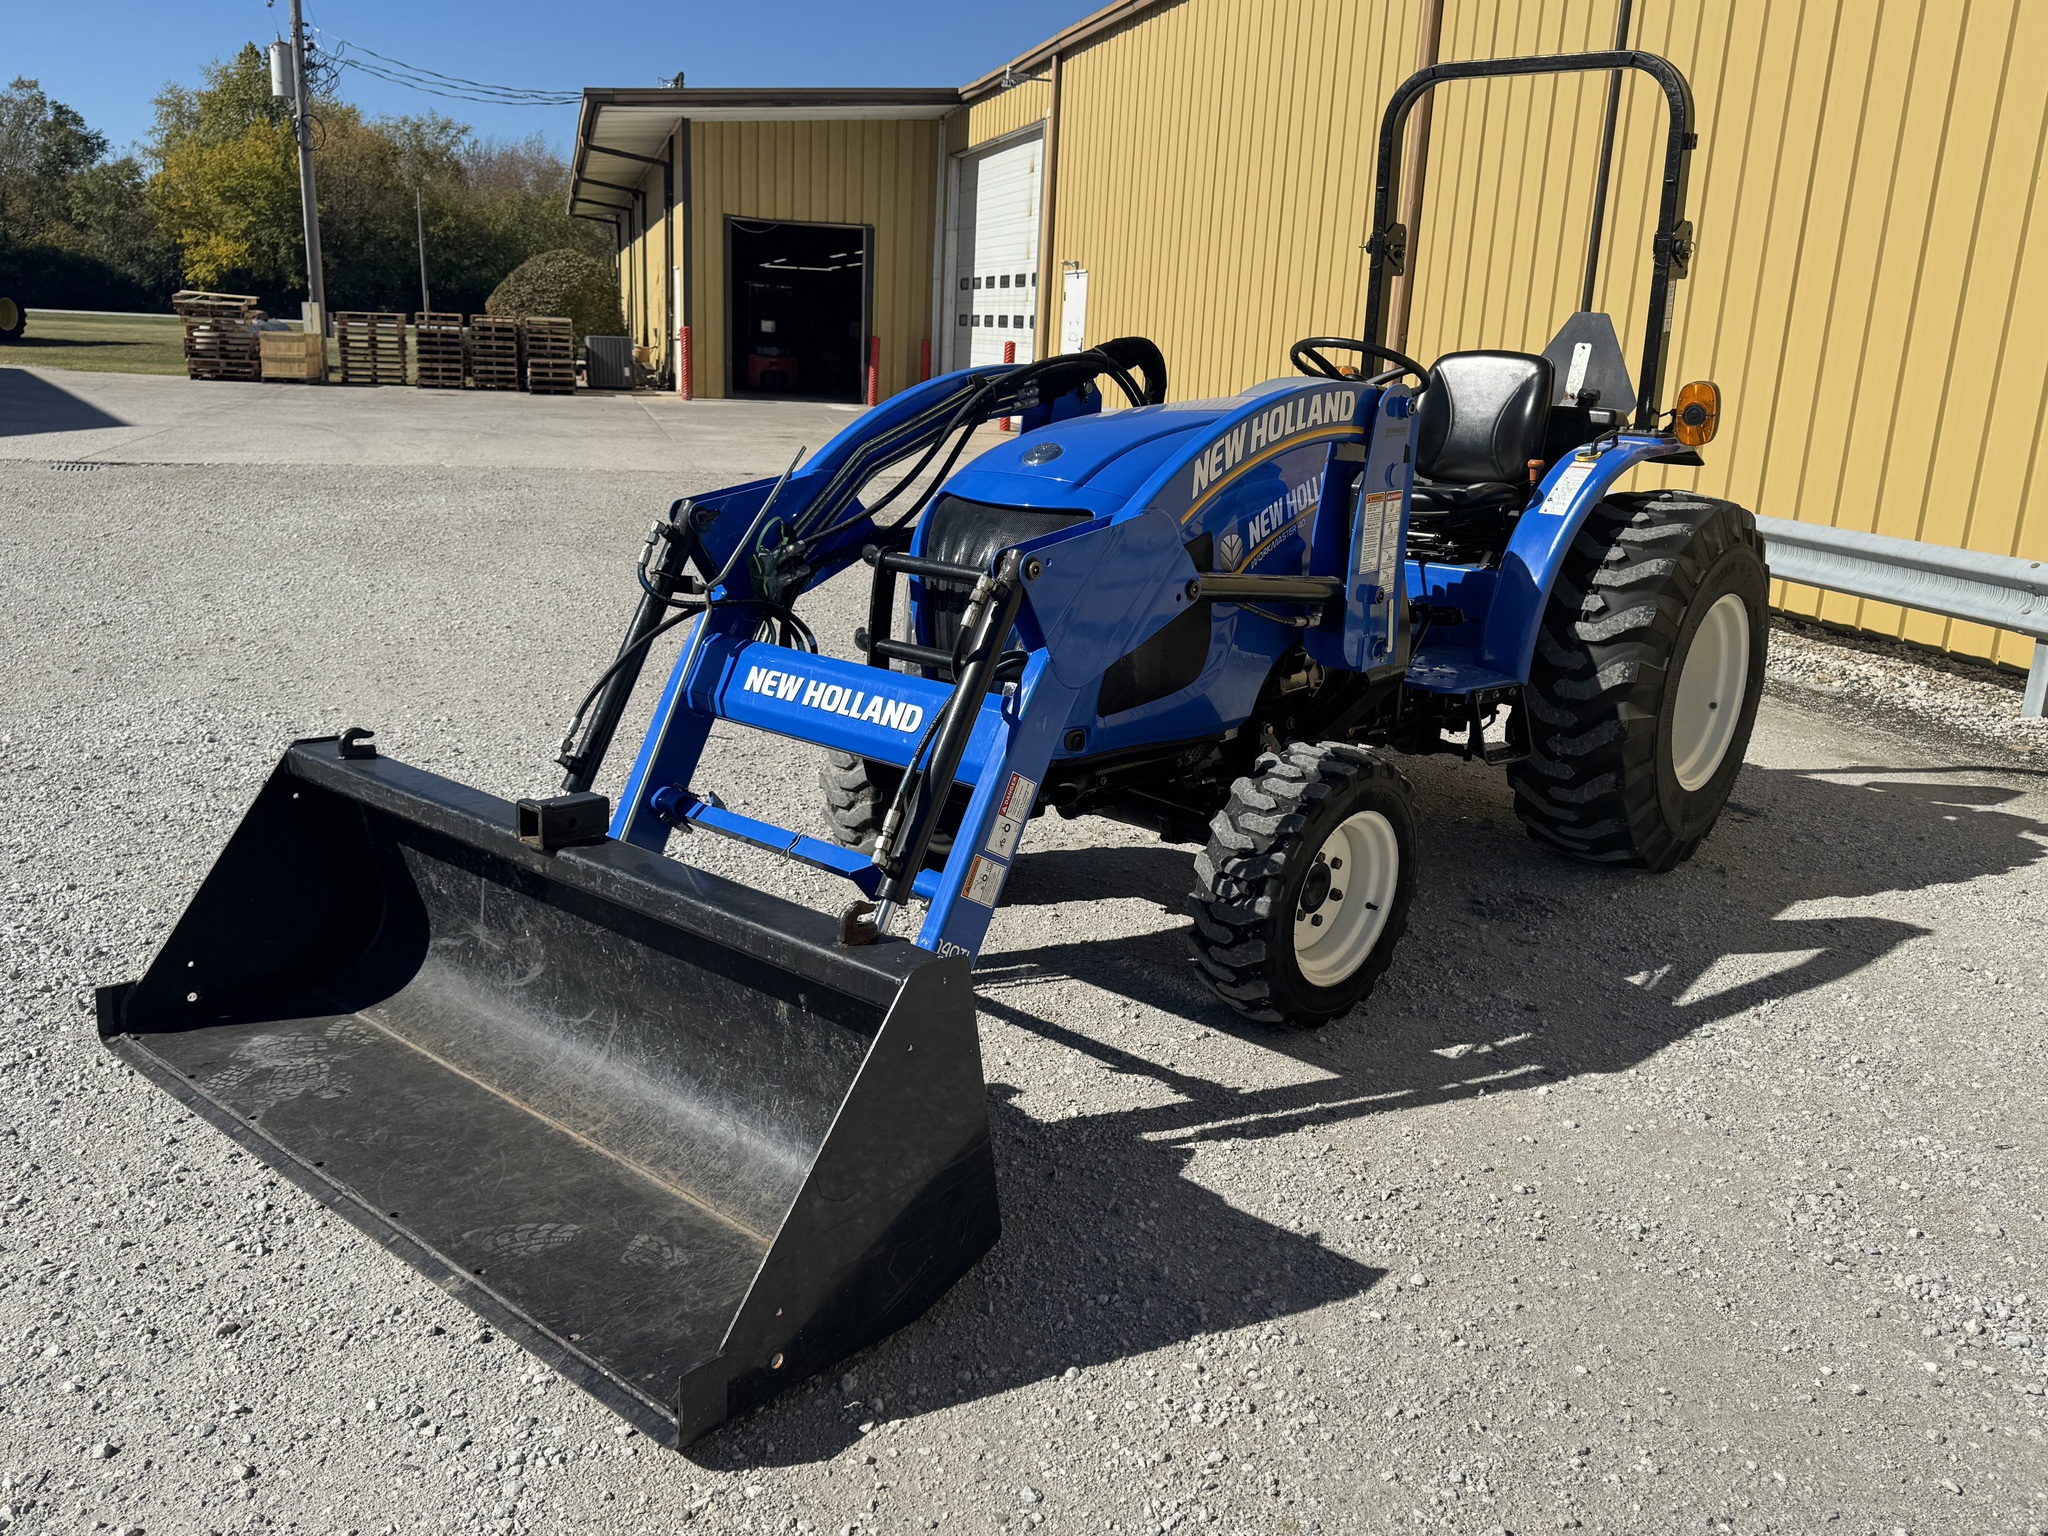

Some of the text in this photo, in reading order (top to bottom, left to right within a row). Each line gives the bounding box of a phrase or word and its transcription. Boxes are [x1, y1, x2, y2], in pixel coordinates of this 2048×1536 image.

[1191, 390, 1356, 500] NEW HOLLAND
[1248, 496, 1283, 550] NEW
[1250, 524, 1297, 570] WORKMASTER
[743, 665, 805, 702] NEW
[801, 680, 924, 734] HOLLAND
[1003, 776, 1018, 805] DANGER
